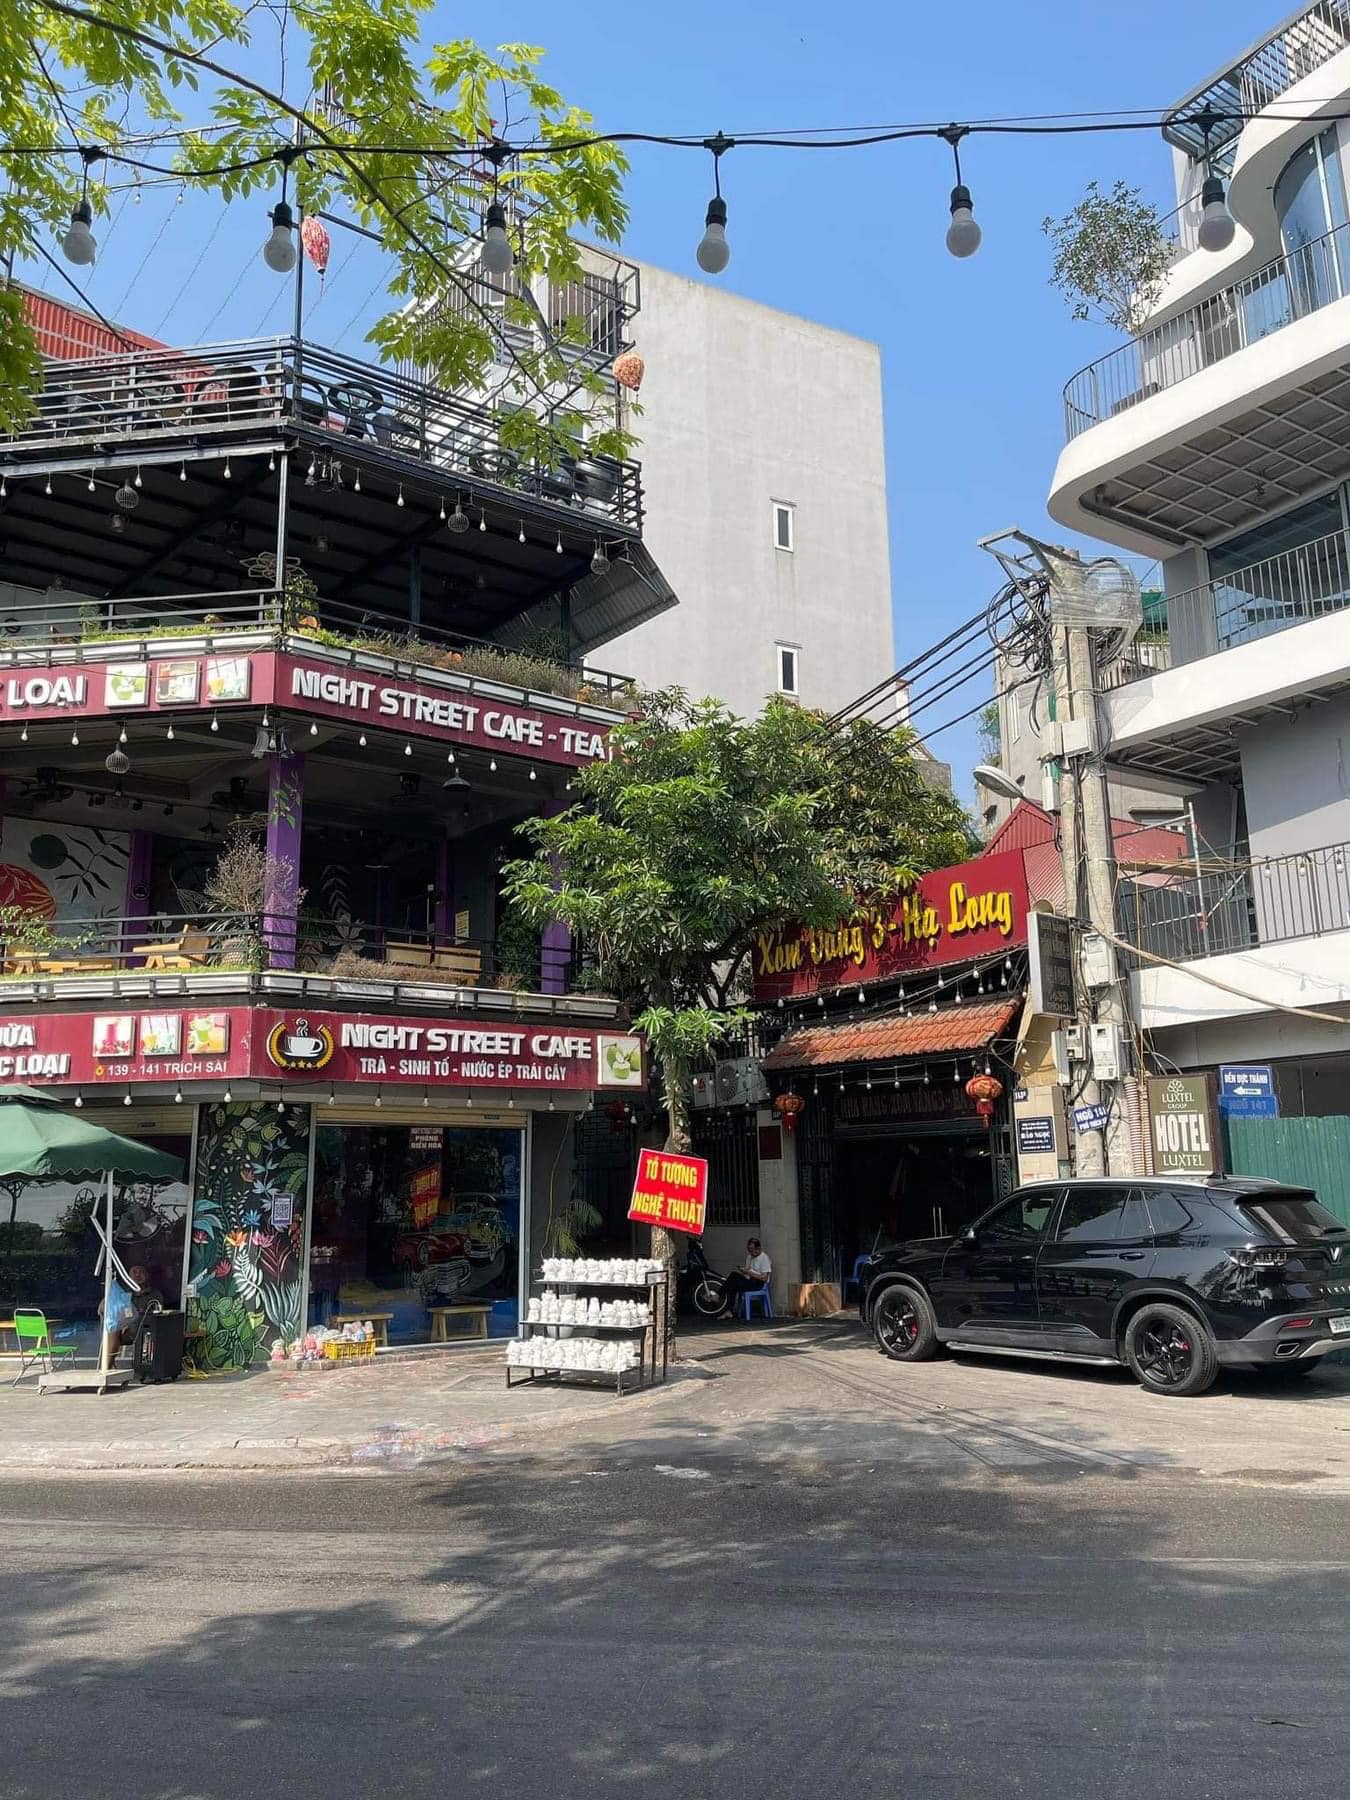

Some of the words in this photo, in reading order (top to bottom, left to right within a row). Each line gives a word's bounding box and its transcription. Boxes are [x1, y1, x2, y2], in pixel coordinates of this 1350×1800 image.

[8, 675, 85, 706] LOẠI
[292, 667, 376, 709] NIGHT
[379, 687, 480, 733] STREET
[483, 711, 544, 747] CAFE
[559, 727, 606, 760] TEA
[947, 882, 1011, 936] Long
[341, 1023, 424, 1050] NIGHT
[427, 1028, 526, 1056] STREET
[532, 1034, 592, 1059] CAFE
[15, 1054, 71, 1078] LOẠI
[107, 1064, 129, 1076] 139
[140, 1063, 159, 1075] 141
[164, 1060, 202, 1074] TRÍCH
[206, 1059, 227, 1073] SÀI
[360, 1055, 387, 1074] TRÀ
[399, 1059, 430, 1076] SINH
[434, 1056, 449, 1077] TỐ
[461, 1060, 494, 1078] NƯỚC
[498, 1061, 513, 1079] ÉP
[516, 1063, 541, 1080] TRÁI
[545, 1063, 567, 1080] CÂY
[1161, 1092, 1195, 1103] LUXTEL
[1155, 1114, 1210, 1152] HOTEL
[1163, 1153, 1205, 1167] LUXTEL
[661, 1161, 698, 1189] TƯỢNG
[632, 1192, 665, 1222] NGHỆ
[666, 1198, 704, 1228] THUẬT
